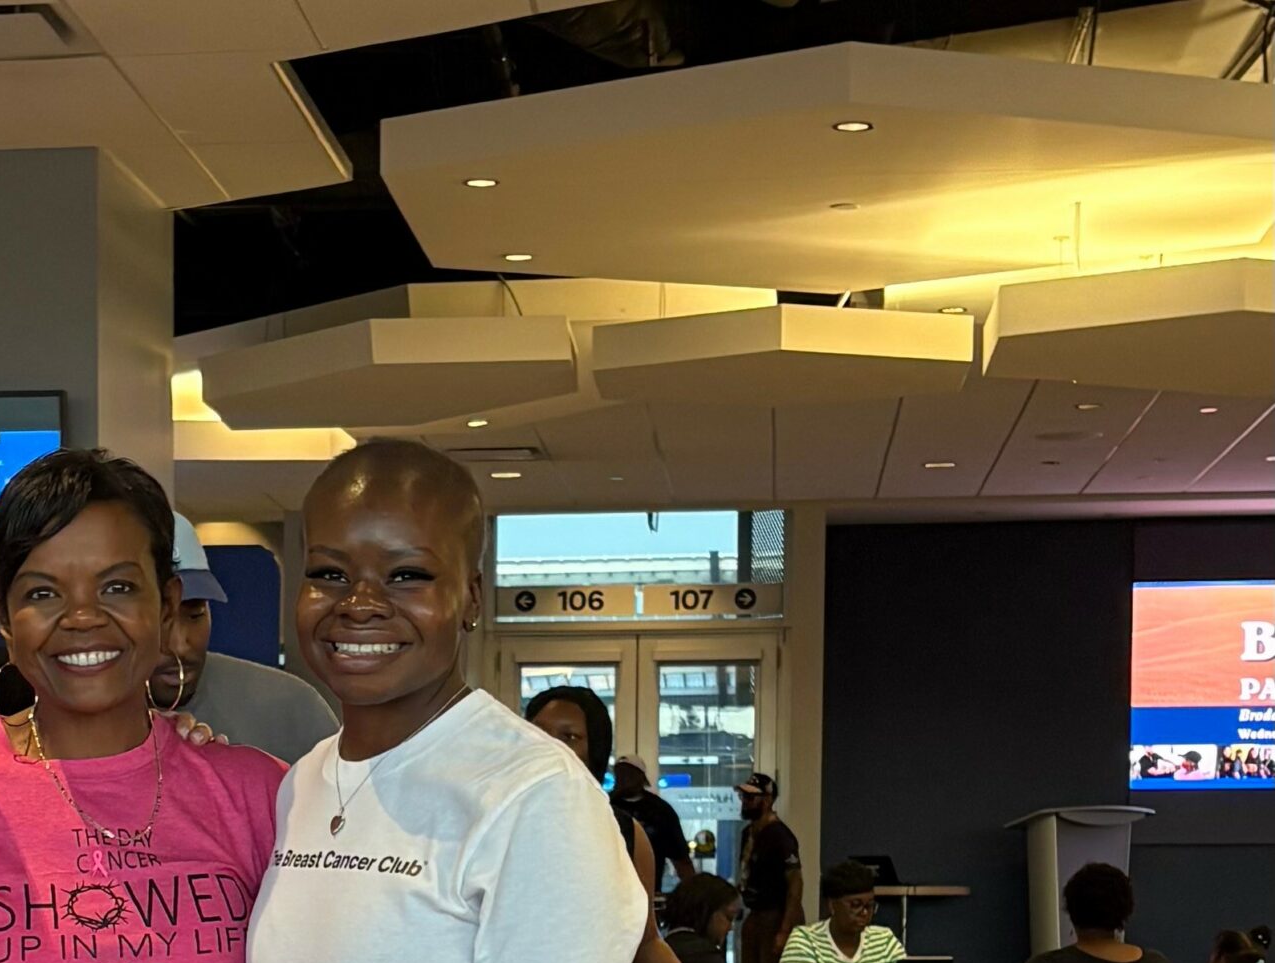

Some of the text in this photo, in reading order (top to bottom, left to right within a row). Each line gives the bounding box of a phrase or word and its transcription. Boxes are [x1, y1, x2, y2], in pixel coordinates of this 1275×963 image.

[557, 590, 605, 611] 106
[670, 589, 714, 610] 107
[72, 827, 154, 848] THE DAY
[282, 850, 323, 868] Breast
[324, 850, 377, 871] Cancer
[377, 856, 423, 877] Club
[61, 934, 98, 960] IN
[118, 931, 178, 958] MY
[195, 926, 249, 955] LIF
